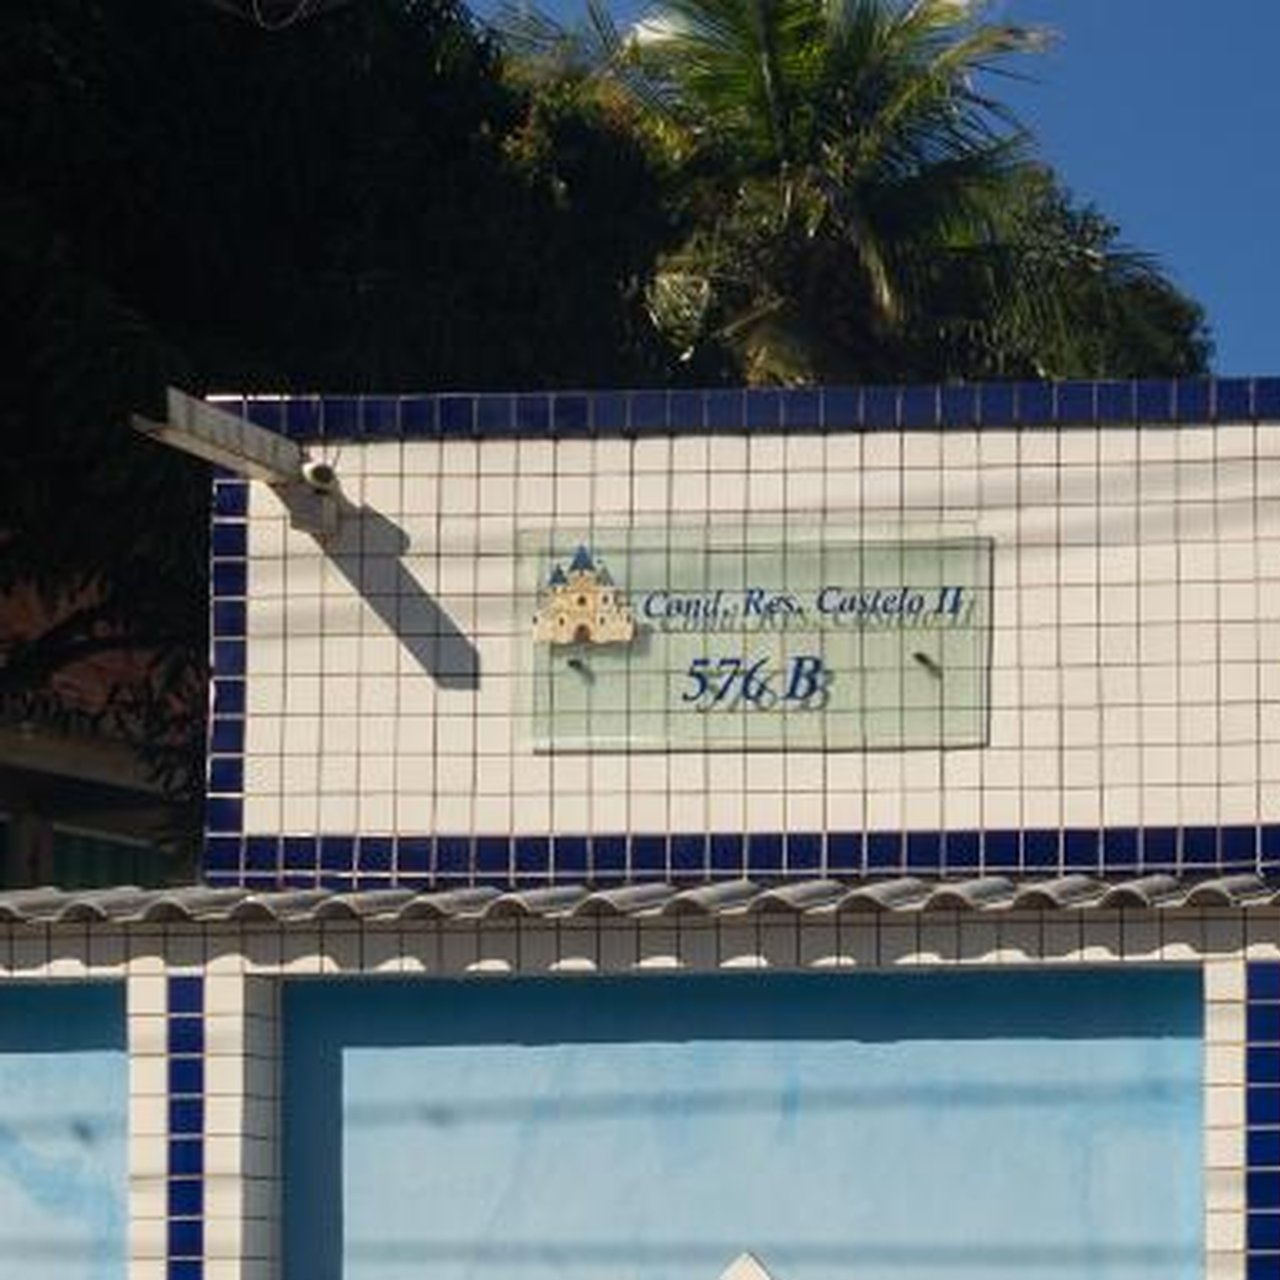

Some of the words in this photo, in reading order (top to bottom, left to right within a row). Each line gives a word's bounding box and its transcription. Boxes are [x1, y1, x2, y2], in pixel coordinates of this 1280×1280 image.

[644, 588, 728, 618] Cond.
[743, 586, 803, 616] Res.
[817, 585, 924, 614] Castelo
[935, 585, 964, 614] II
[682, 656, 769, 702] 576
[785, 655, 822, 701] B
